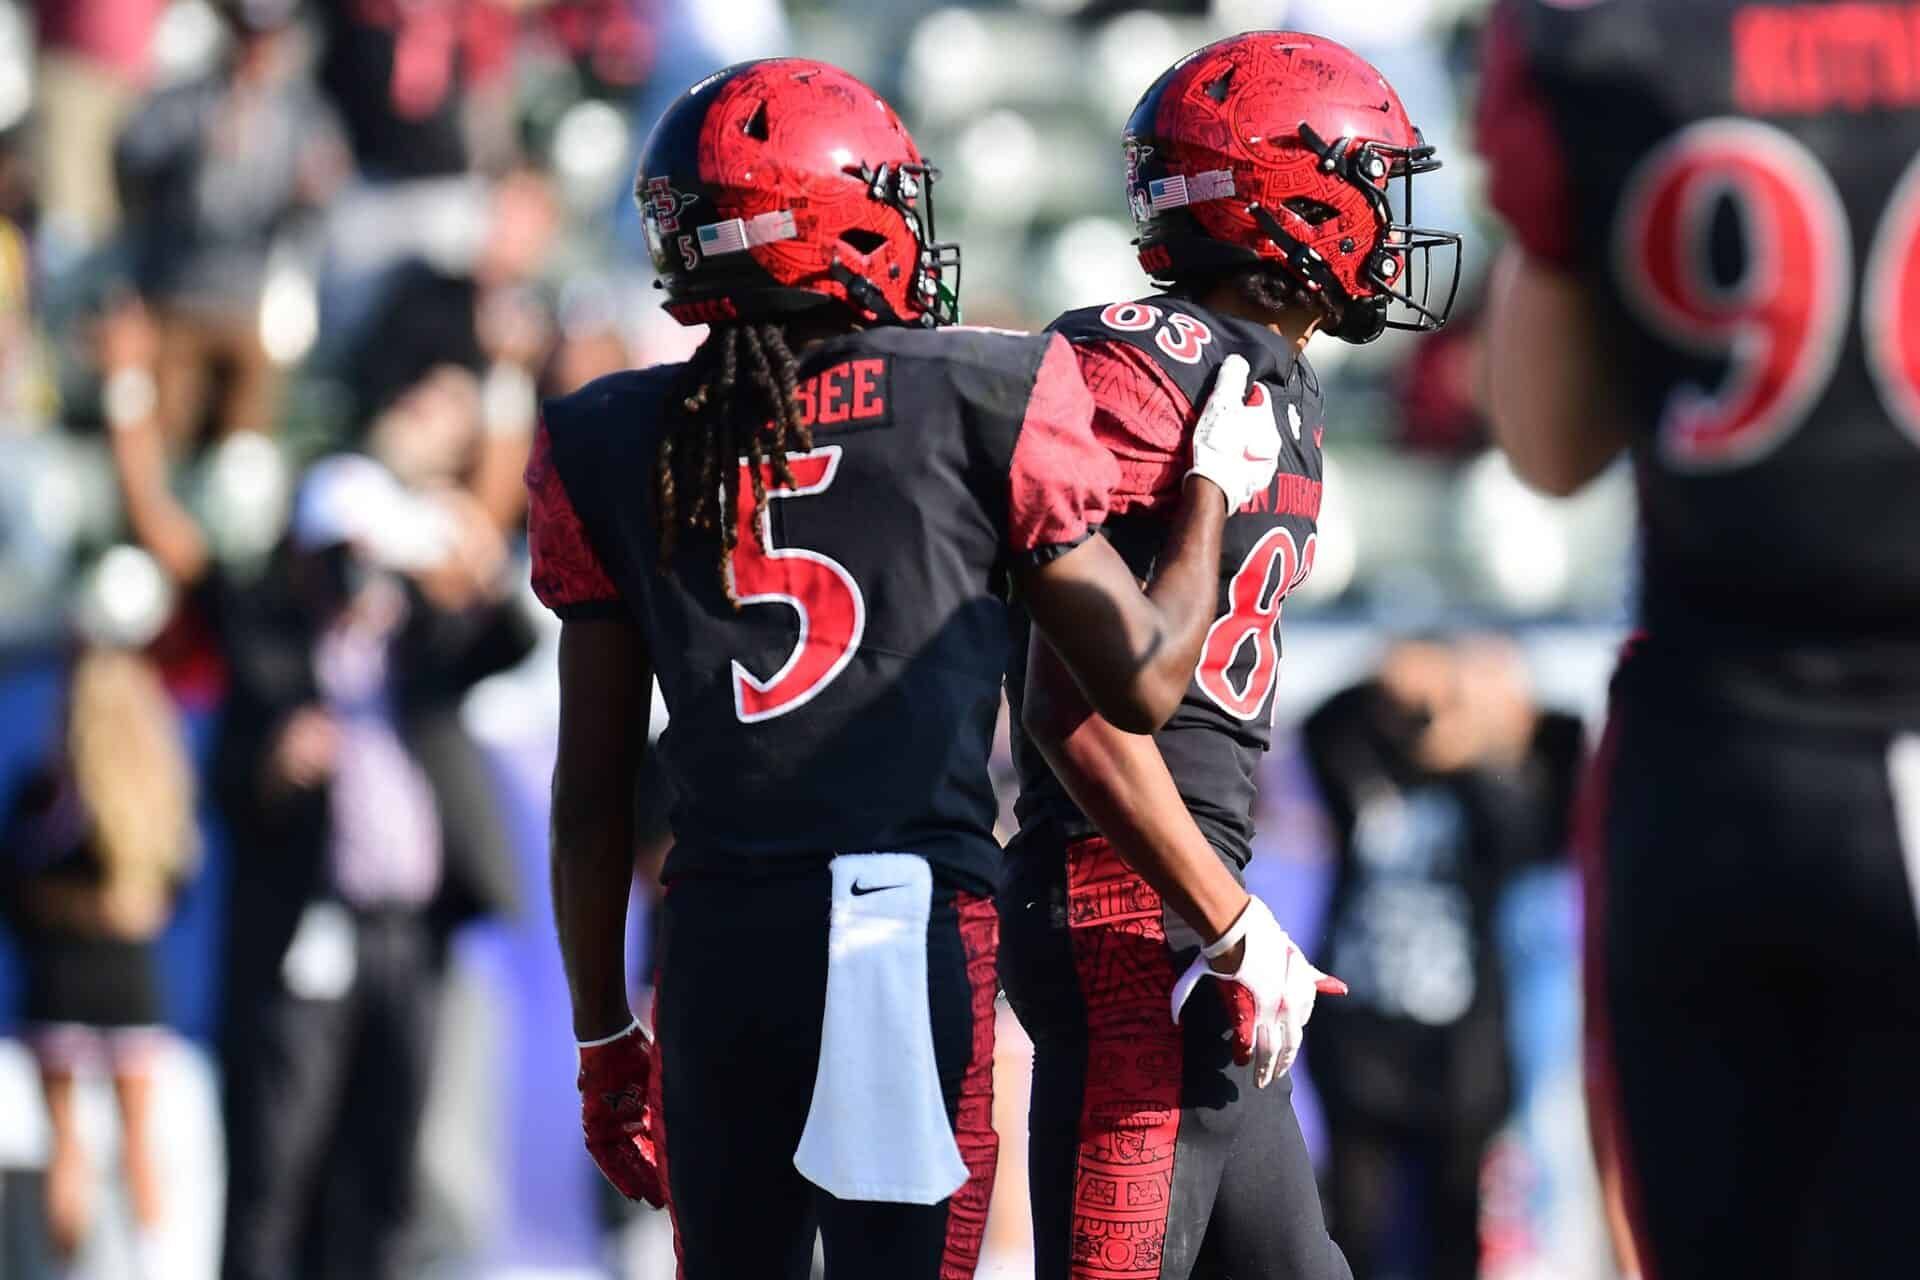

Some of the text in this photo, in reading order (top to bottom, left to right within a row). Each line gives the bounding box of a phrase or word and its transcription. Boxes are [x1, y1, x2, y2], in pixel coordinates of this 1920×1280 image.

[677, 234, 699, 271] 5
[1613, 117, 1920, 475] 9
[720, 445, 866, 723] 5
